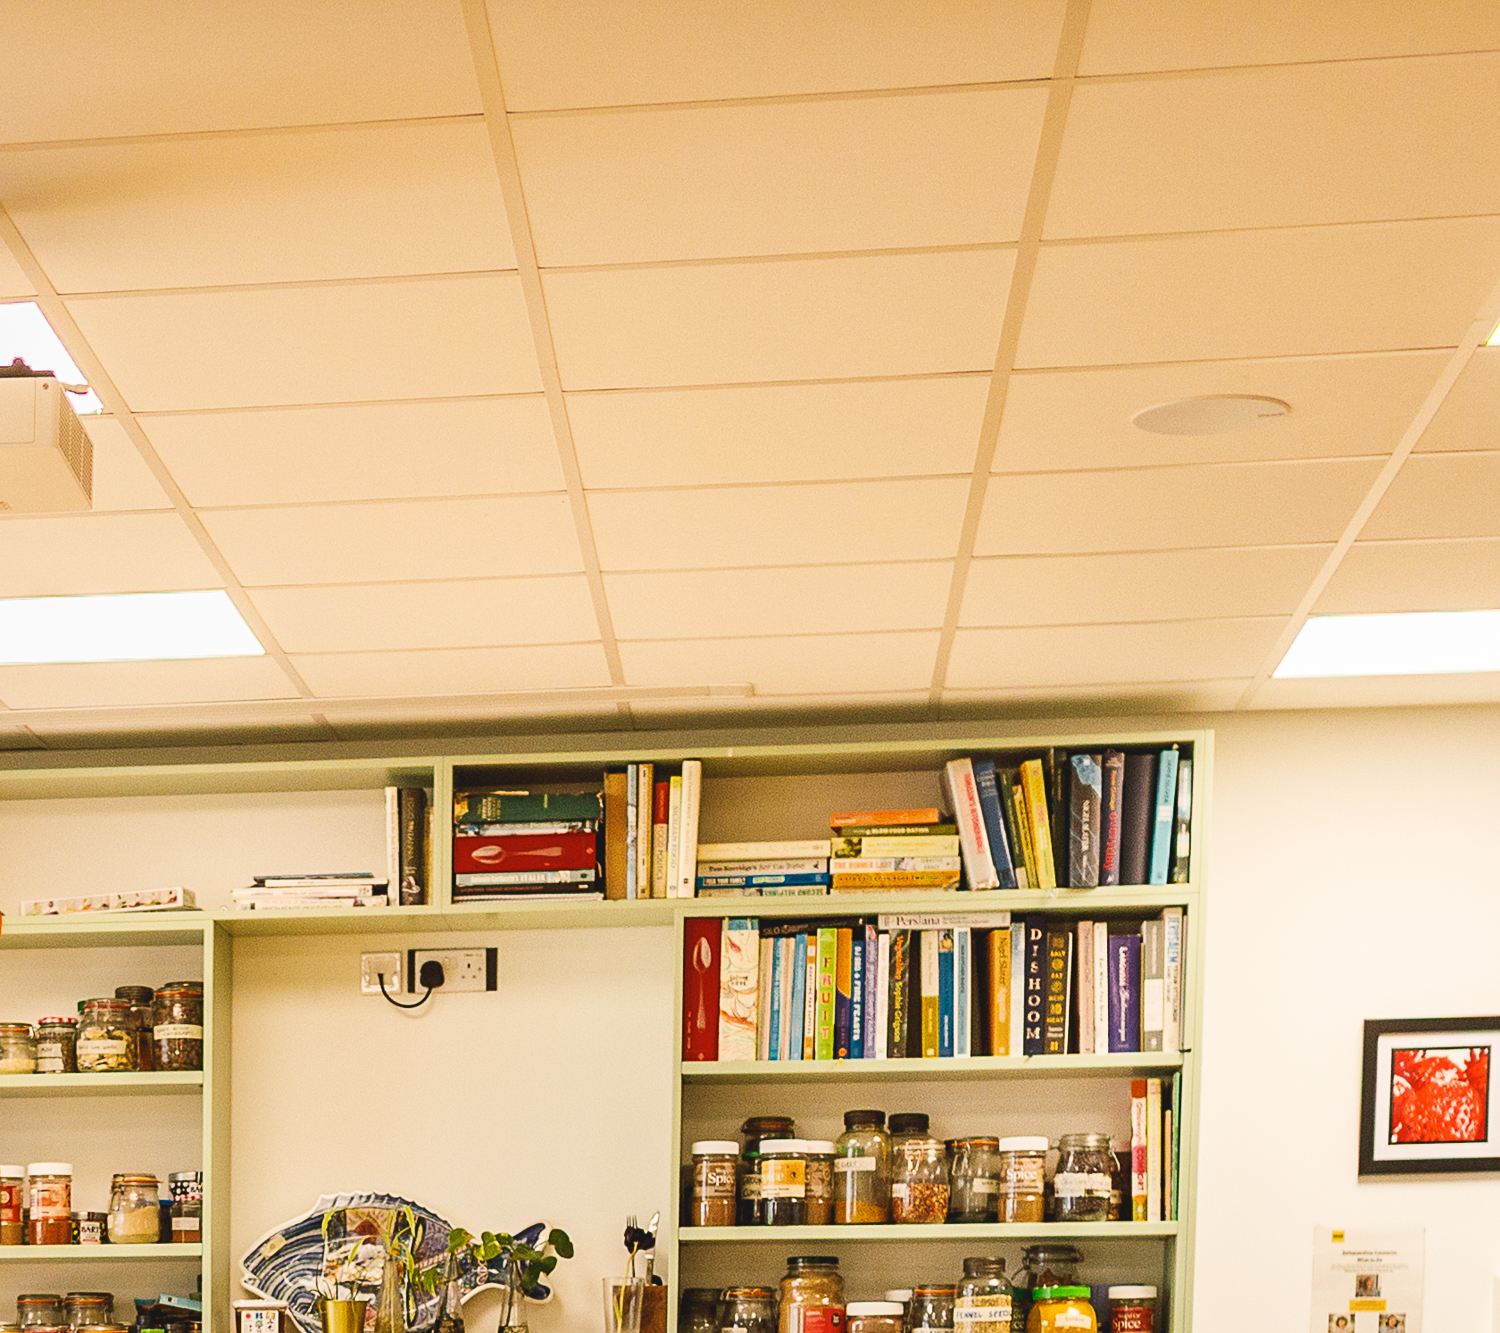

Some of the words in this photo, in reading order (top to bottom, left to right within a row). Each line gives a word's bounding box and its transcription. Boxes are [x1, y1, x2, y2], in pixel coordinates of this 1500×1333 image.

[895, 915, 941, 927] Persiana
[998, 937, 1007, 962] Nigel
[1167, 916, 1180, 963] JERUSALEM
[894, 934, 904, 980] Vegetables
[998, 964, 1007, 986] Slater
[1026, 928, 1042, 1040] DISHOOM
[819, 956, 832, 1040] FRUIT
[894, 981, 903, 1010] Sophie
[853, 1004, 861, 1041] FEASTS
[892, 1010, 903, 1043] Grigson
[1006, 1169, 1038, 1181] Spice
[1113, 1317, 1141, 1331] Spice
